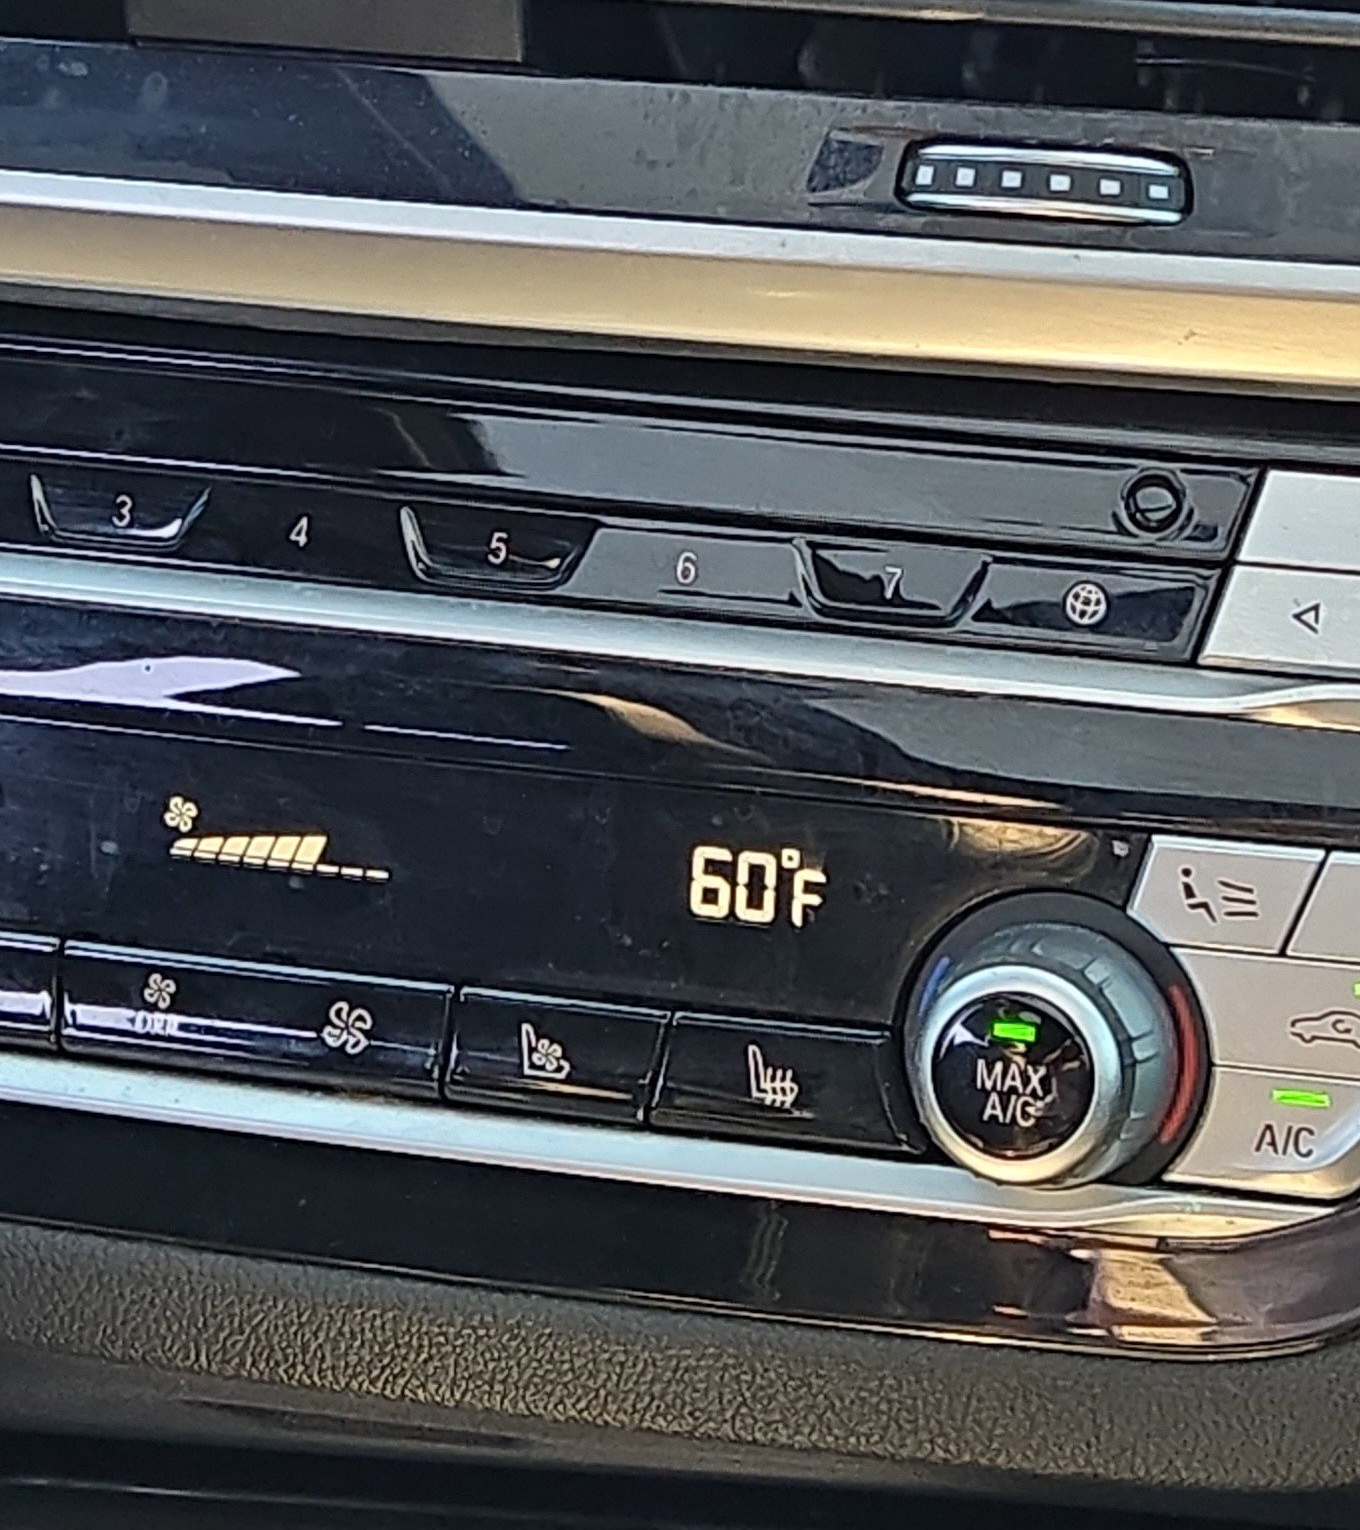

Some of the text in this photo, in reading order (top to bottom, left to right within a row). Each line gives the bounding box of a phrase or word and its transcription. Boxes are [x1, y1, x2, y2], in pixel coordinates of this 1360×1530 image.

[111, 496, 134, 527] 3
[288, 516, 310, 548] 4
[488, 532, 509, 565] 5
[675, 552, 698, 584] 6
[884, 568, 902, 599] 7
[976, 1058, 1047, 1098] MAX
[982, 1090, 1037, 1128] A/C
[1254, 1123, 1316, 1158] A/C
